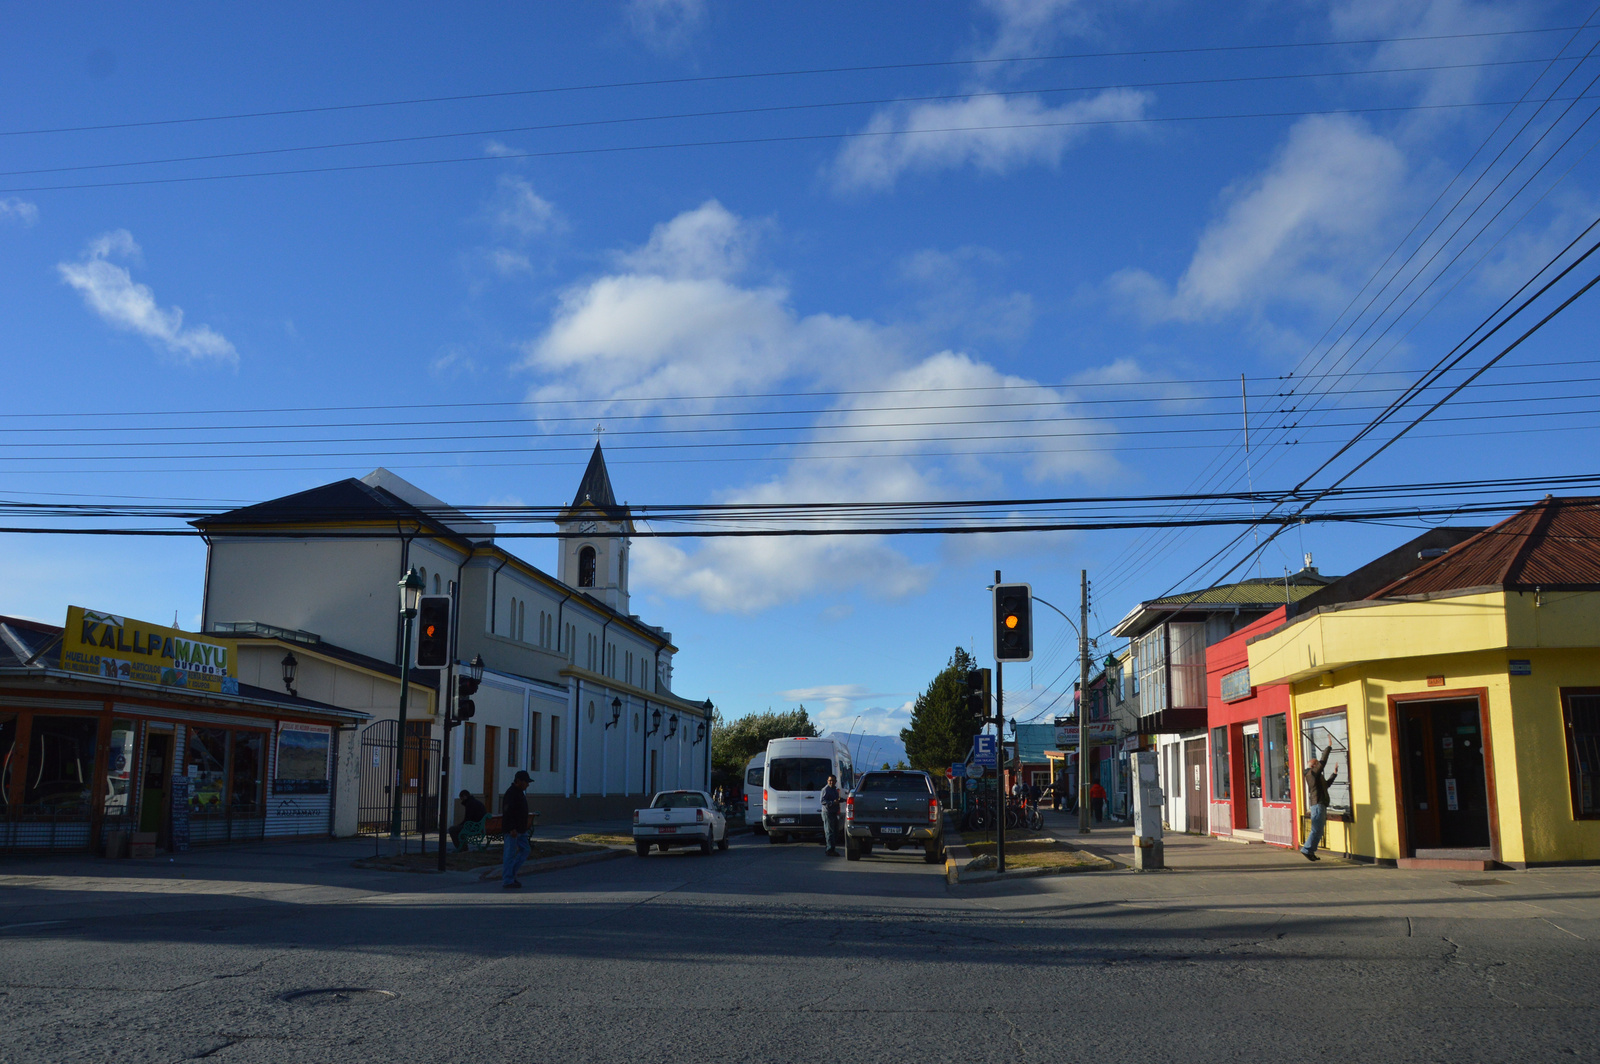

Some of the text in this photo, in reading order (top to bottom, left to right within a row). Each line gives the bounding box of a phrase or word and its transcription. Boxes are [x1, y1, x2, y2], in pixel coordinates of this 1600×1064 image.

[81, 619, 228, 668] KALLPAMAYU
[65, 650, 101, 666] HUELLAS
[978, 737, 991, 753] E
